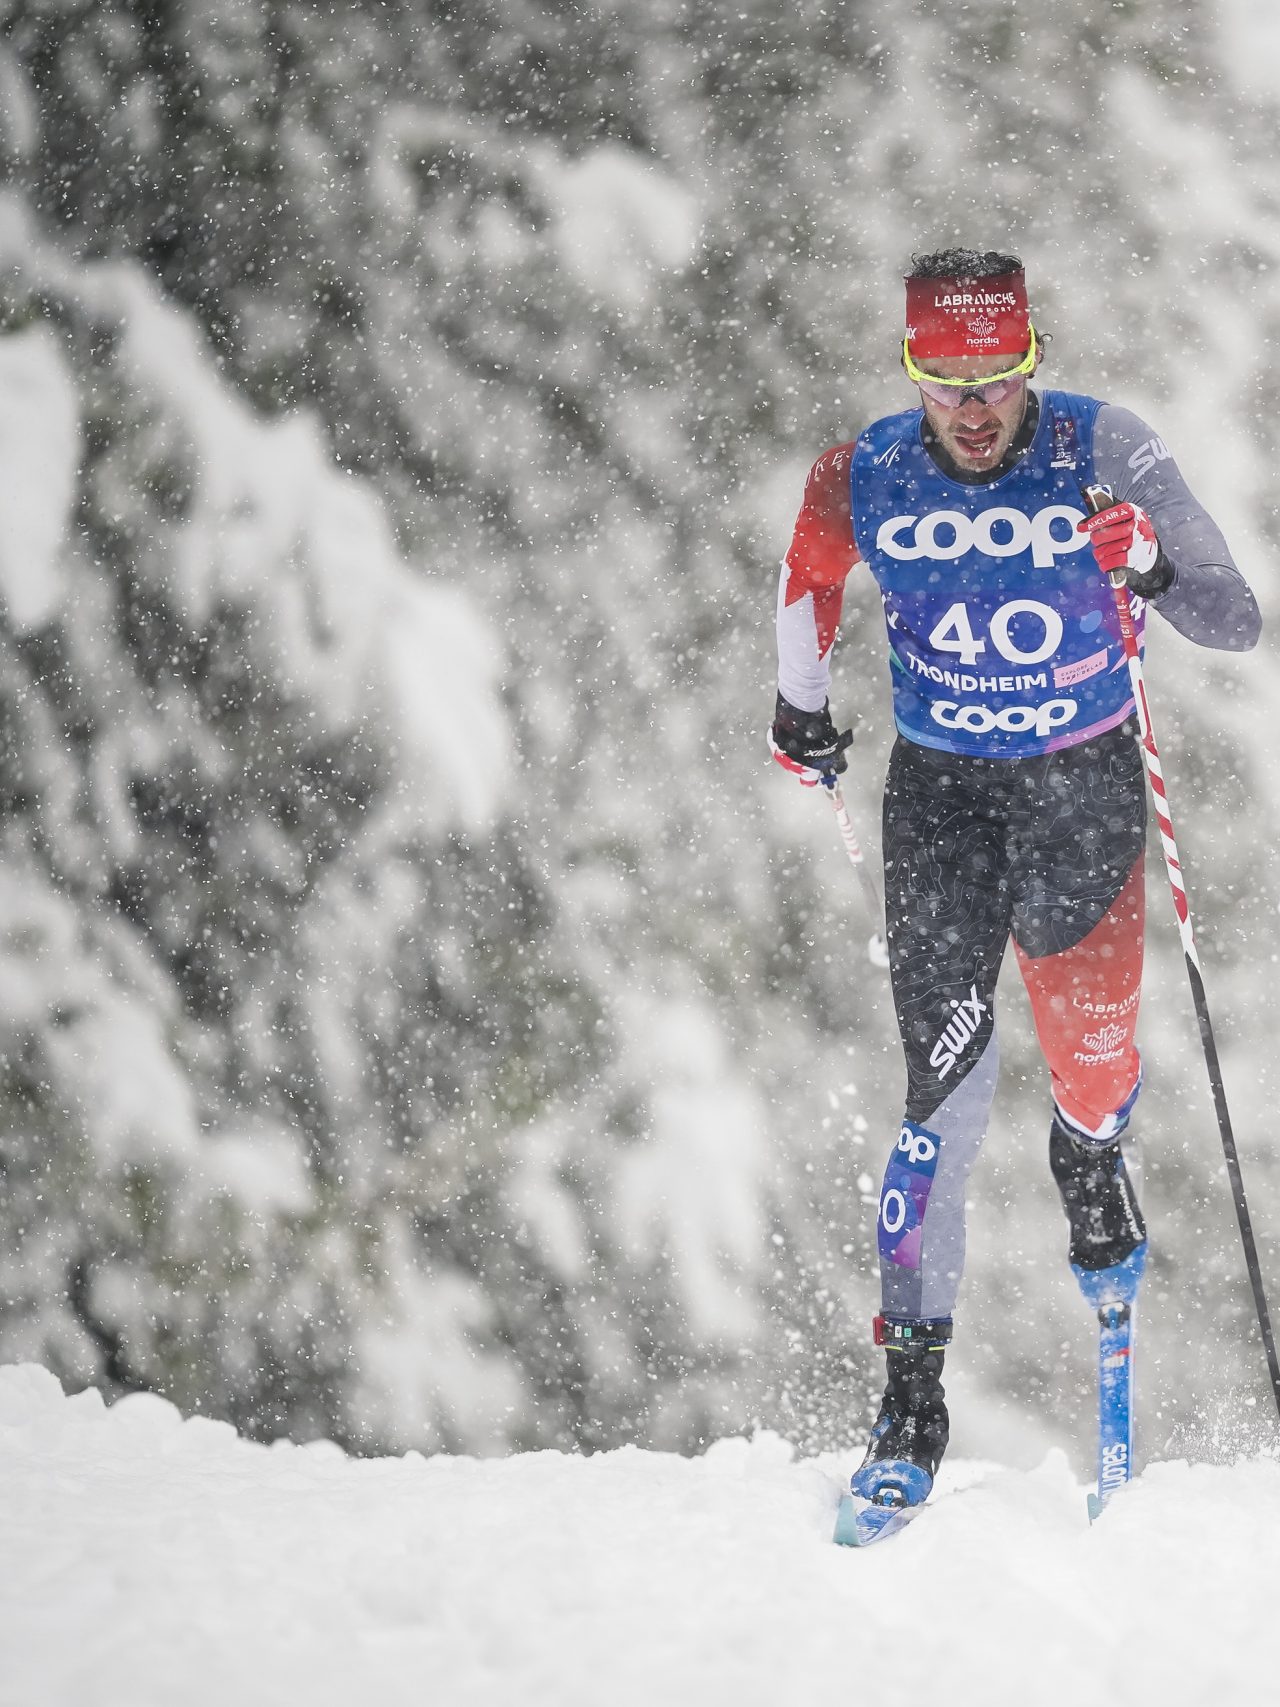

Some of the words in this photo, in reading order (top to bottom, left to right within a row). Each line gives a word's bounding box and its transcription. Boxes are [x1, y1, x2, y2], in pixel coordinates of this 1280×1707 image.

[934, 292, 1015, 307] LABRANCHE
[944, 306, 1011, 314] TRANSPORT
[966, 337, 1000, 345] nordiq
[877, 505, 1091, 568] coop
[1087, 511, 1119, 531] AUCLAIR
[928, 599, 1063, 666] 40
[907, 652, 1047, 692] TRONDHEIM
[930, 699, 1078, 737] coop
[930, 983, 987, 1080] swix
[898, 1127, 935, 1164] op
